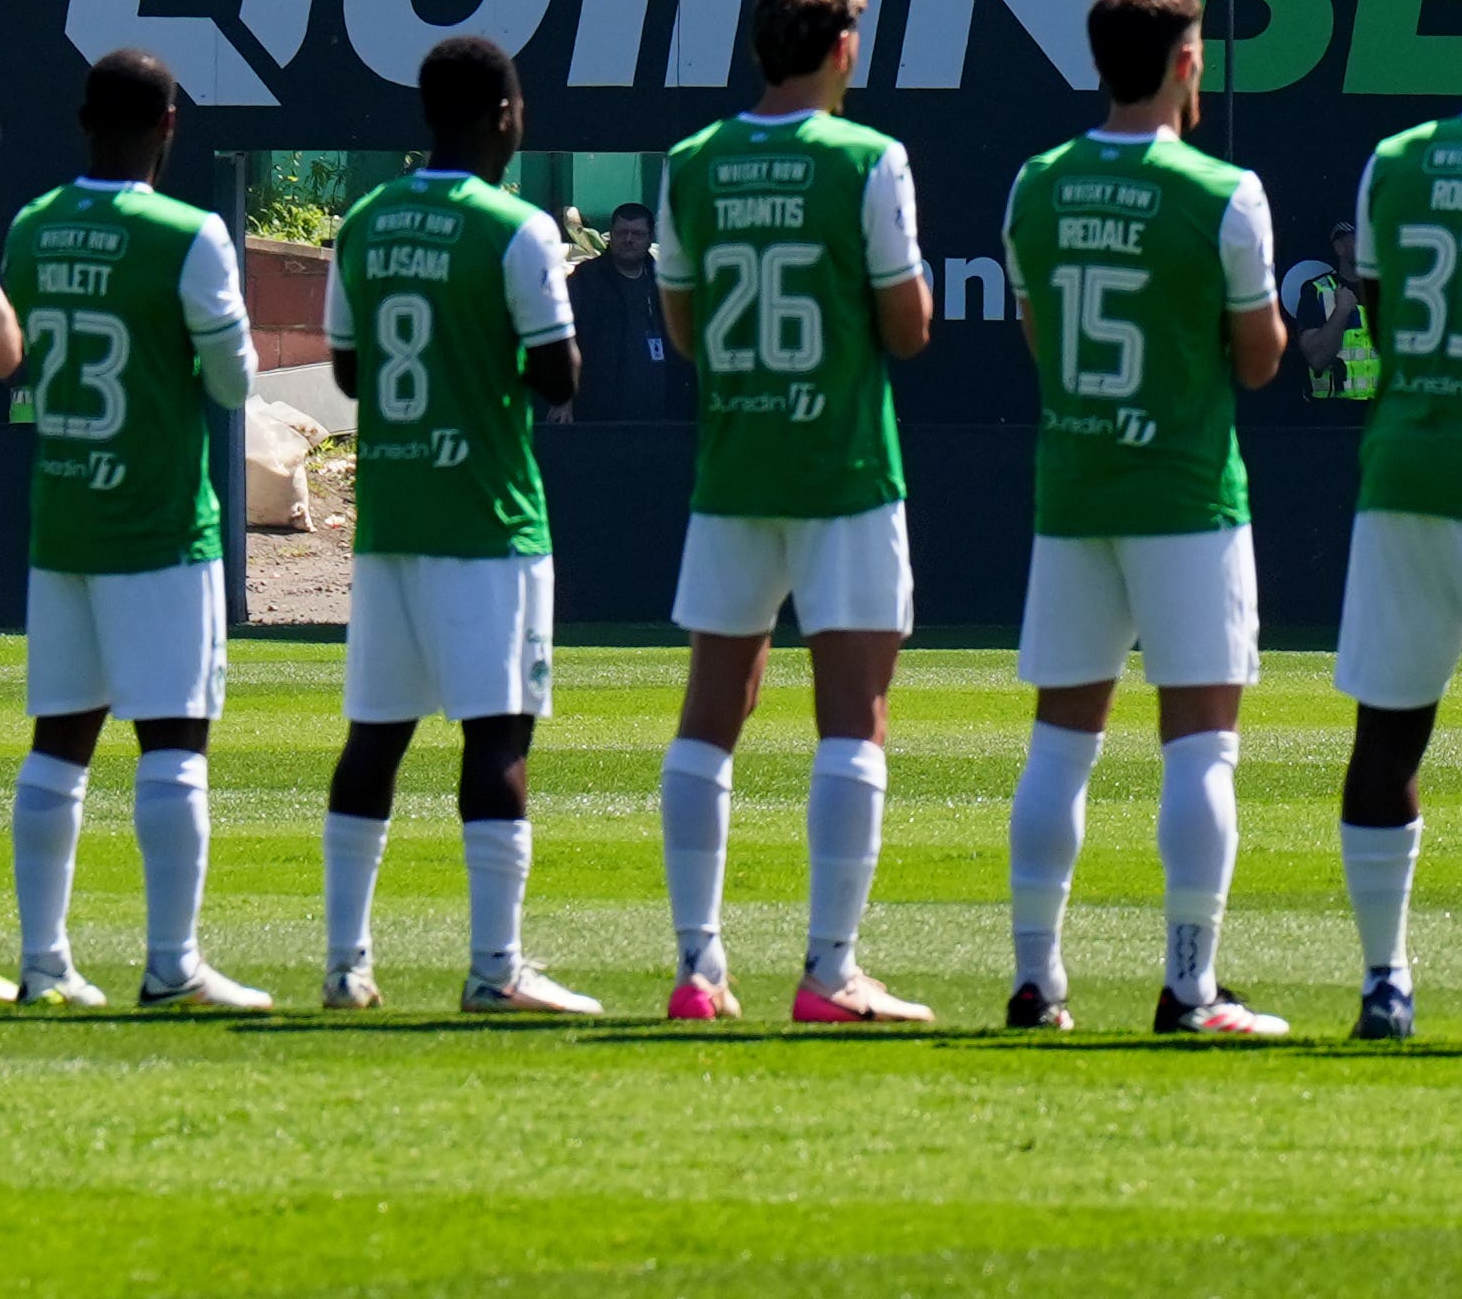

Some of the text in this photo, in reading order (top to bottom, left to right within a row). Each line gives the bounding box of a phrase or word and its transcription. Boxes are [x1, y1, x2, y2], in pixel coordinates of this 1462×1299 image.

[376, 291, 434, 423] 8
[703, 241, 826, 373] 26
[1049, 264, 1152, 397] 15
[27, 306, 131, 442] 23
